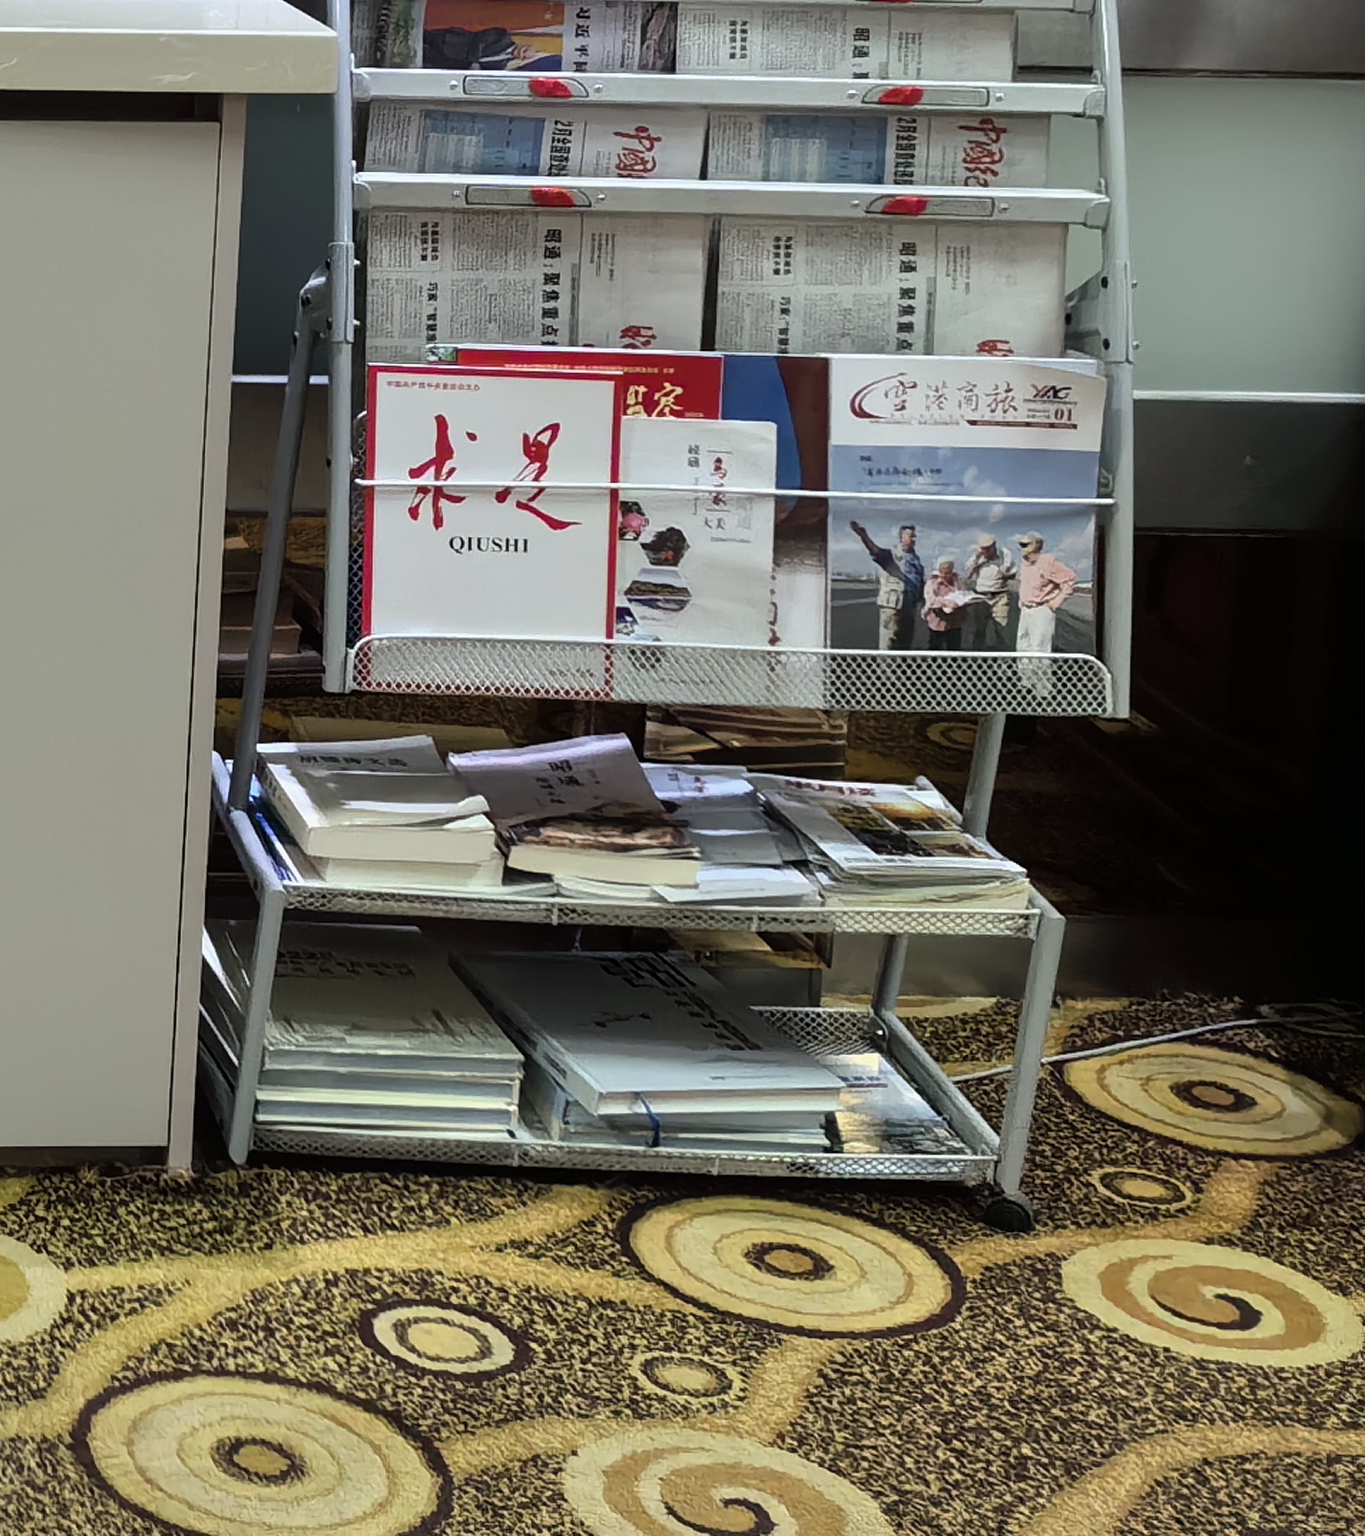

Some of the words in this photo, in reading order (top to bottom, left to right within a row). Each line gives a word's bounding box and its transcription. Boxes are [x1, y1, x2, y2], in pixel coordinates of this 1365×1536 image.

[1053, 408, 1073, 421] 01
[407, 414, 582, 531] 求是
[448, 536, 529, 554] QIUSHI
